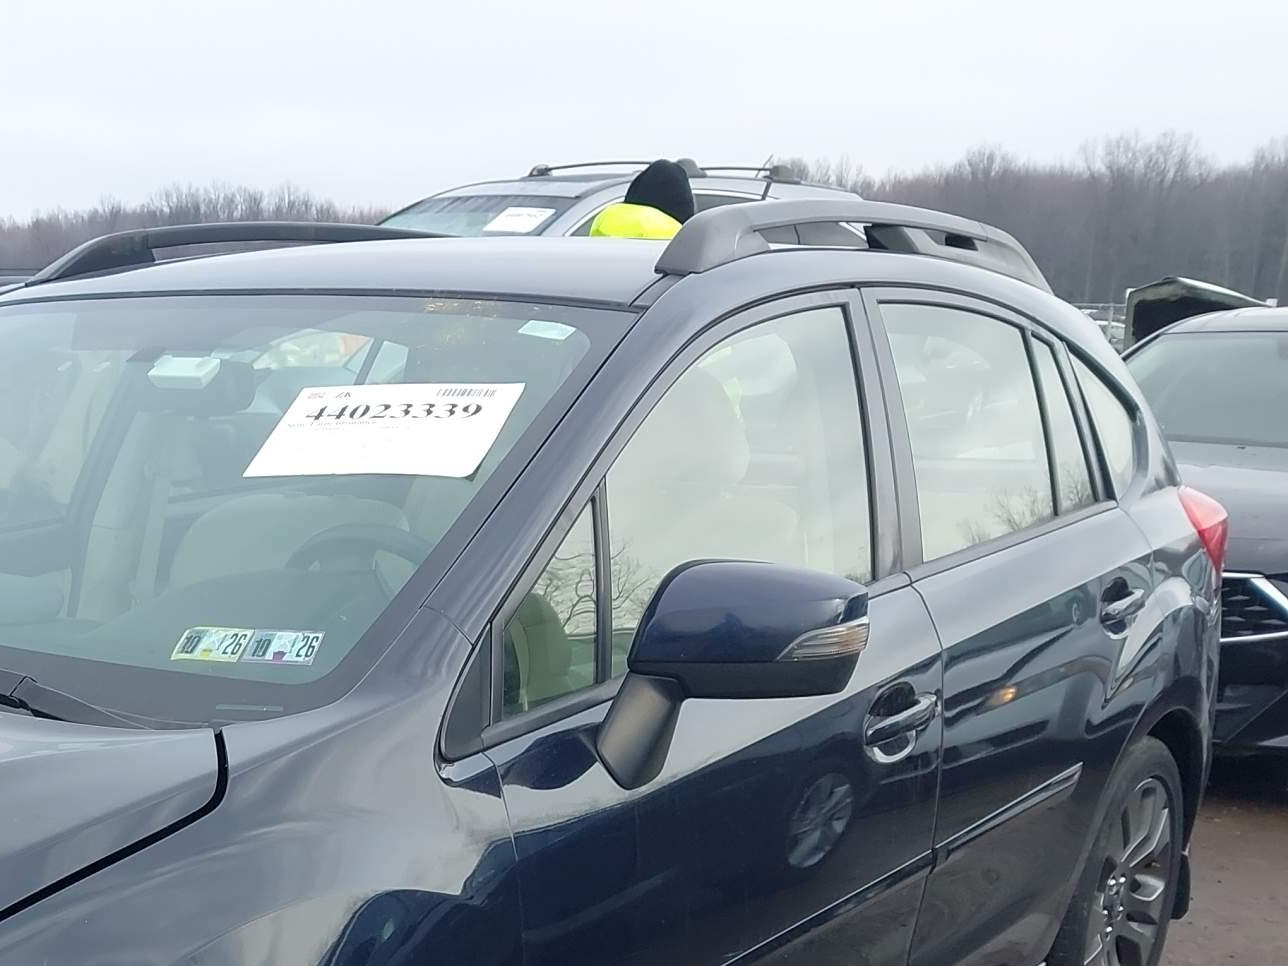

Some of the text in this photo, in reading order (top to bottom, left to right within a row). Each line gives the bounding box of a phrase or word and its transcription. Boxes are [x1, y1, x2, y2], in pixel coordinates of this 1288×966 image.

[305, 403, 483, 421] 44023339
[222, 632, 247, 655] 26
[295, 635, 320, 657] 26
